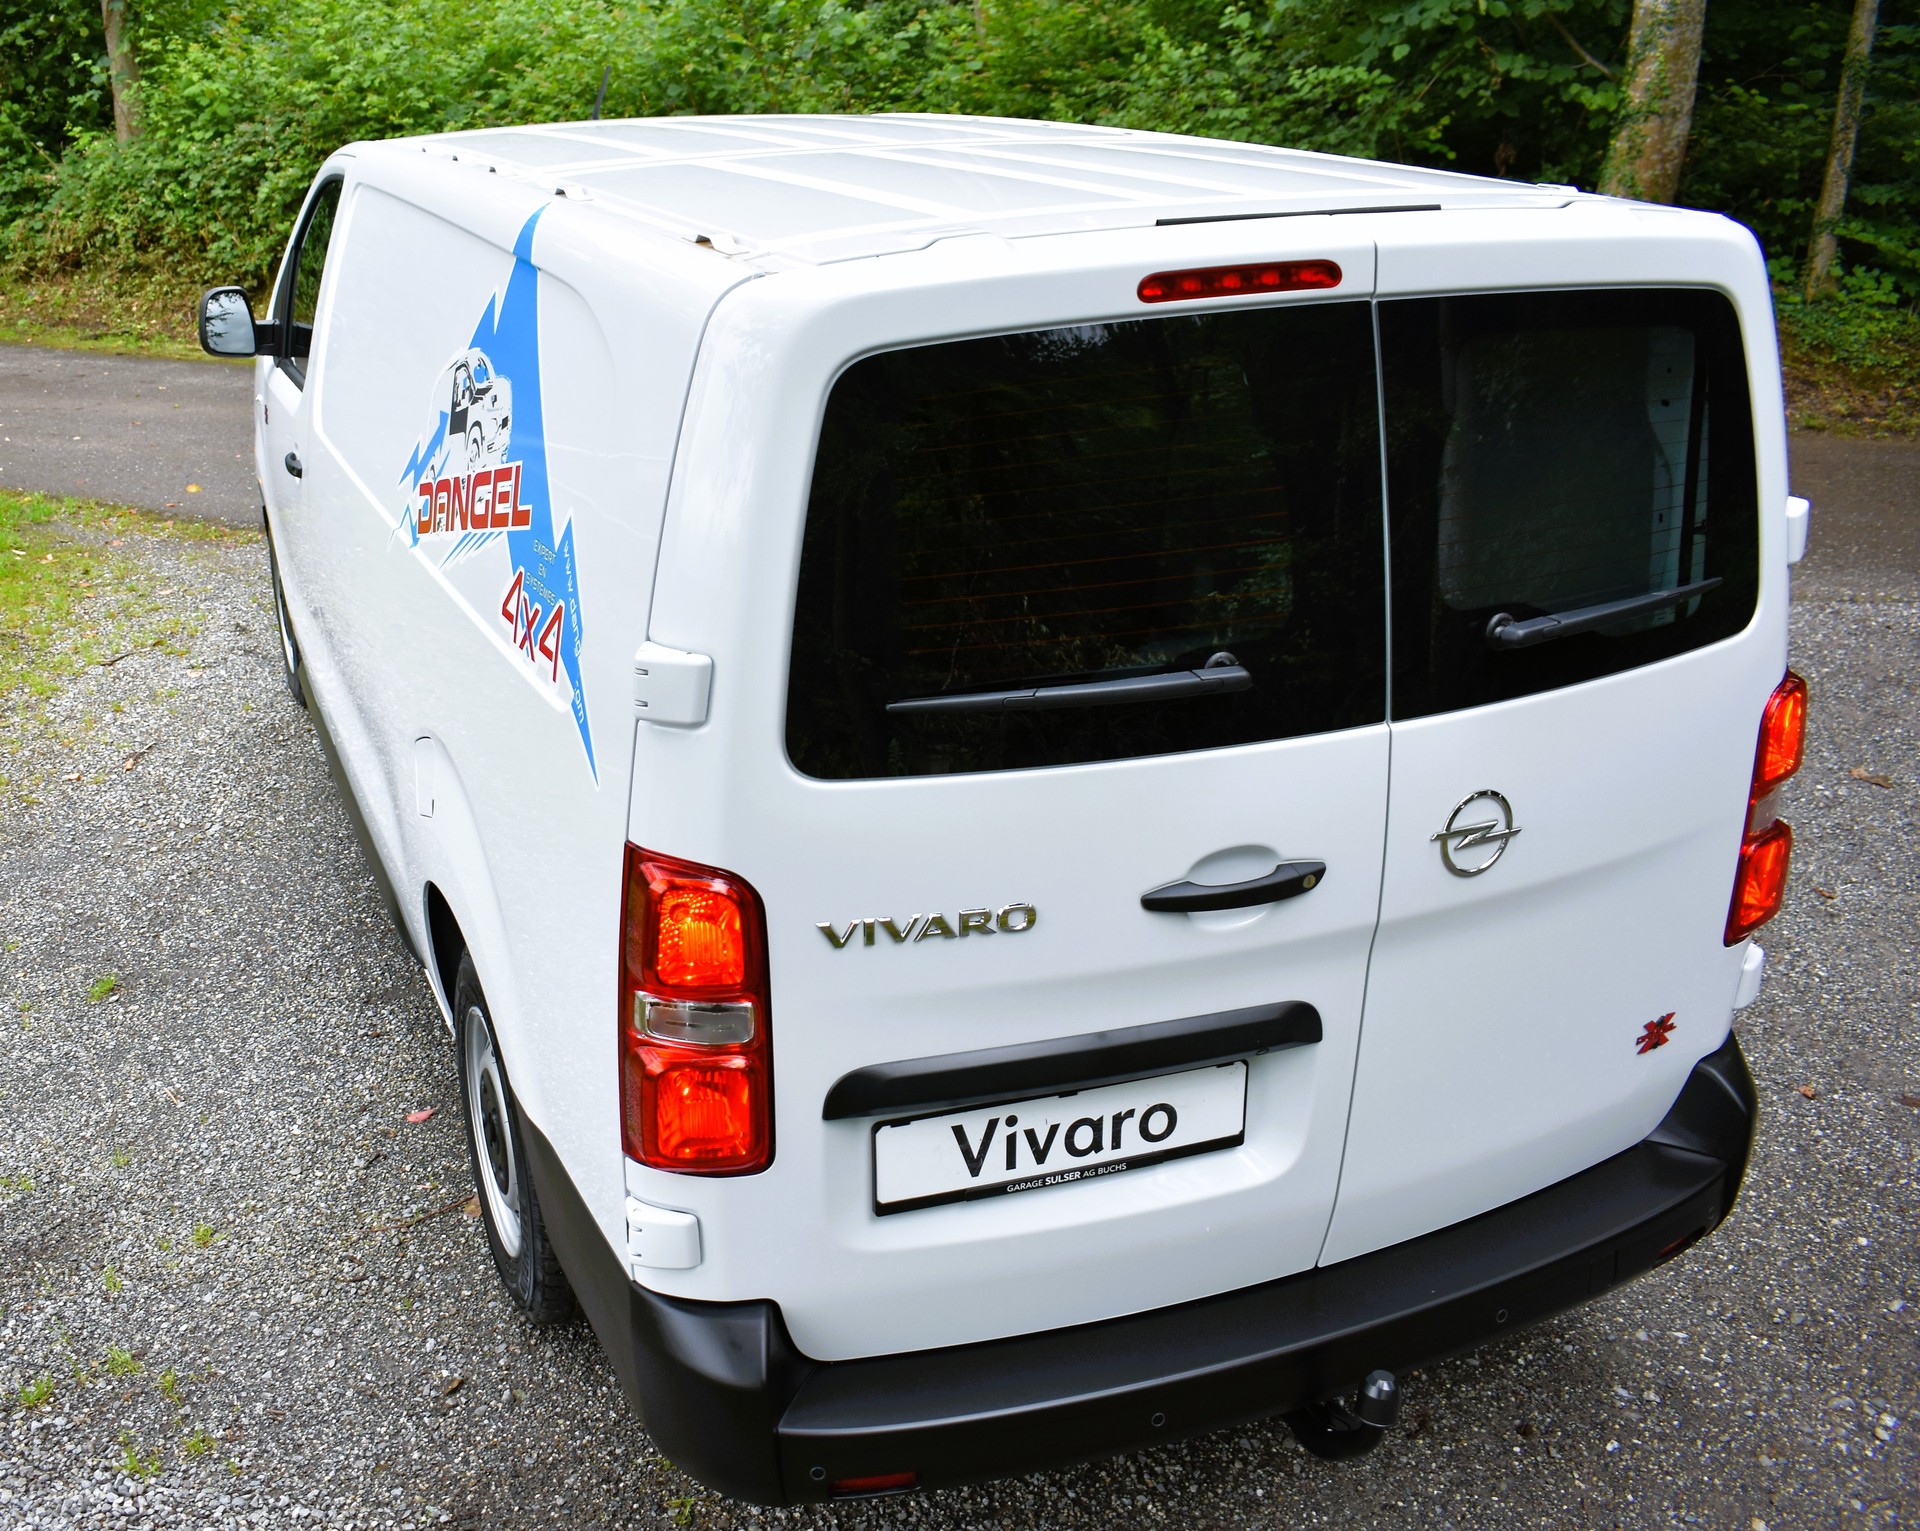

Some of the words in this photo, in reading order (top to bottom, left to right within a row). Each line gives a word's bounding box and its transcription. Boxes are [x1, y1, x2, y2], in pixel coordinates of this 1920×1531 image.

[417, 464, 531, 534] DANGEL
[533, 539, 557, 566] EXPERT
[538, 562, 547, 578] EN
[815, 902, 1037, 949] VIVARO
[951, 1102, 1178, 1178] Vivaro
[1006, 1179, 1044, 1192] GARAGE
[1045, 1171, 1081, 1186] SULSER
[1082, 1168, 1096, 1178] AG
[1097, 1162, 1127, 1175] BUCHS
